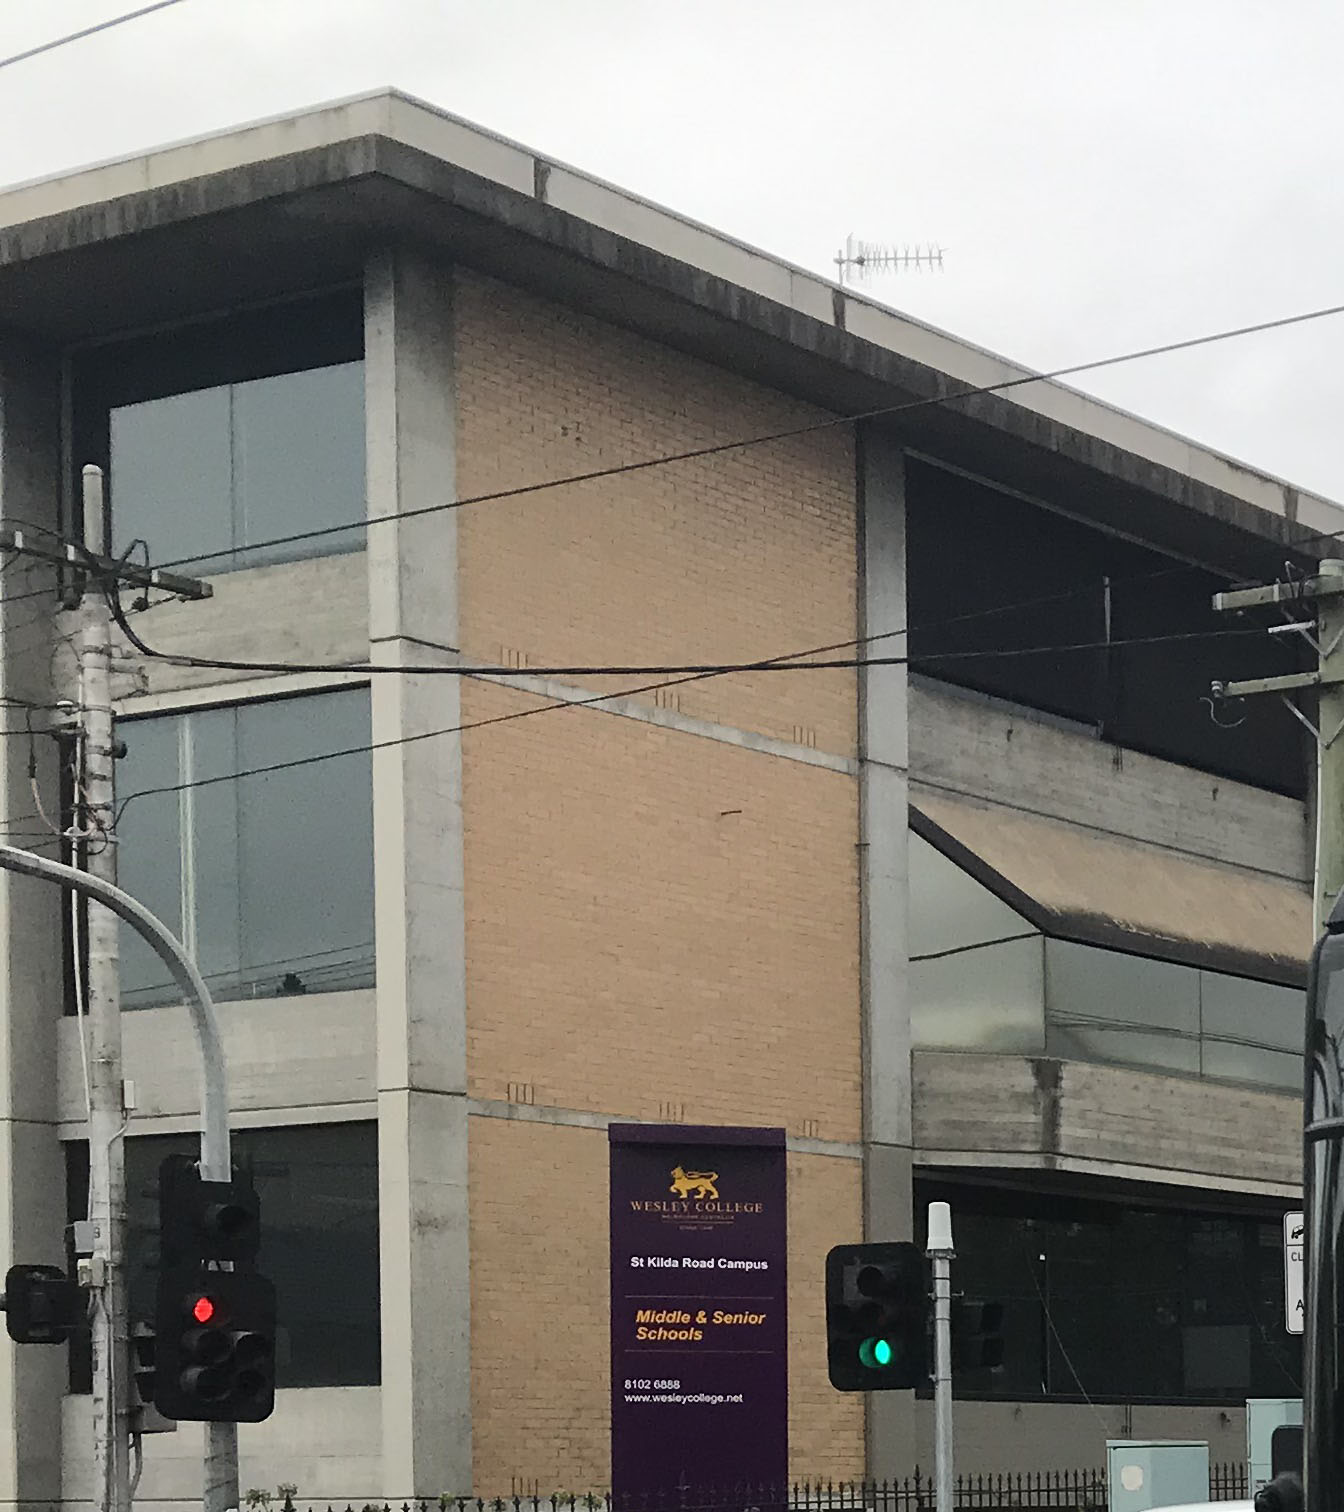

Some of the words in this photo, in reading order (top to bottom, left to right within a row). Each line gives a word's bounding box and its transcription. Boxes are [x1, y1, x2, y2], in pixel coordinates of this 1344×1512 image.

[630, 1201, 690, 1213] WESLEY
[695, 1202, 764, 1214] COLLEGE
[630, 1256, 645, 1268] St
[647, 1257, 679, 1269] Kilda
[682, 1257, 715, 1269] Road
[717, 1258, 769, 1272] Campus
[635, 1309, 691, 1324] Middle
[695, 1310, 708, 1324] &
[712, 1310, 767, 1325] Senior
[635, 1326, 703, 1341] Schools
[624, 1379, 651, 1390] 8102
[653, 1379, 681, 1390] 6888
[624, 1392, 744, 1405] www.wesleycollege.net
